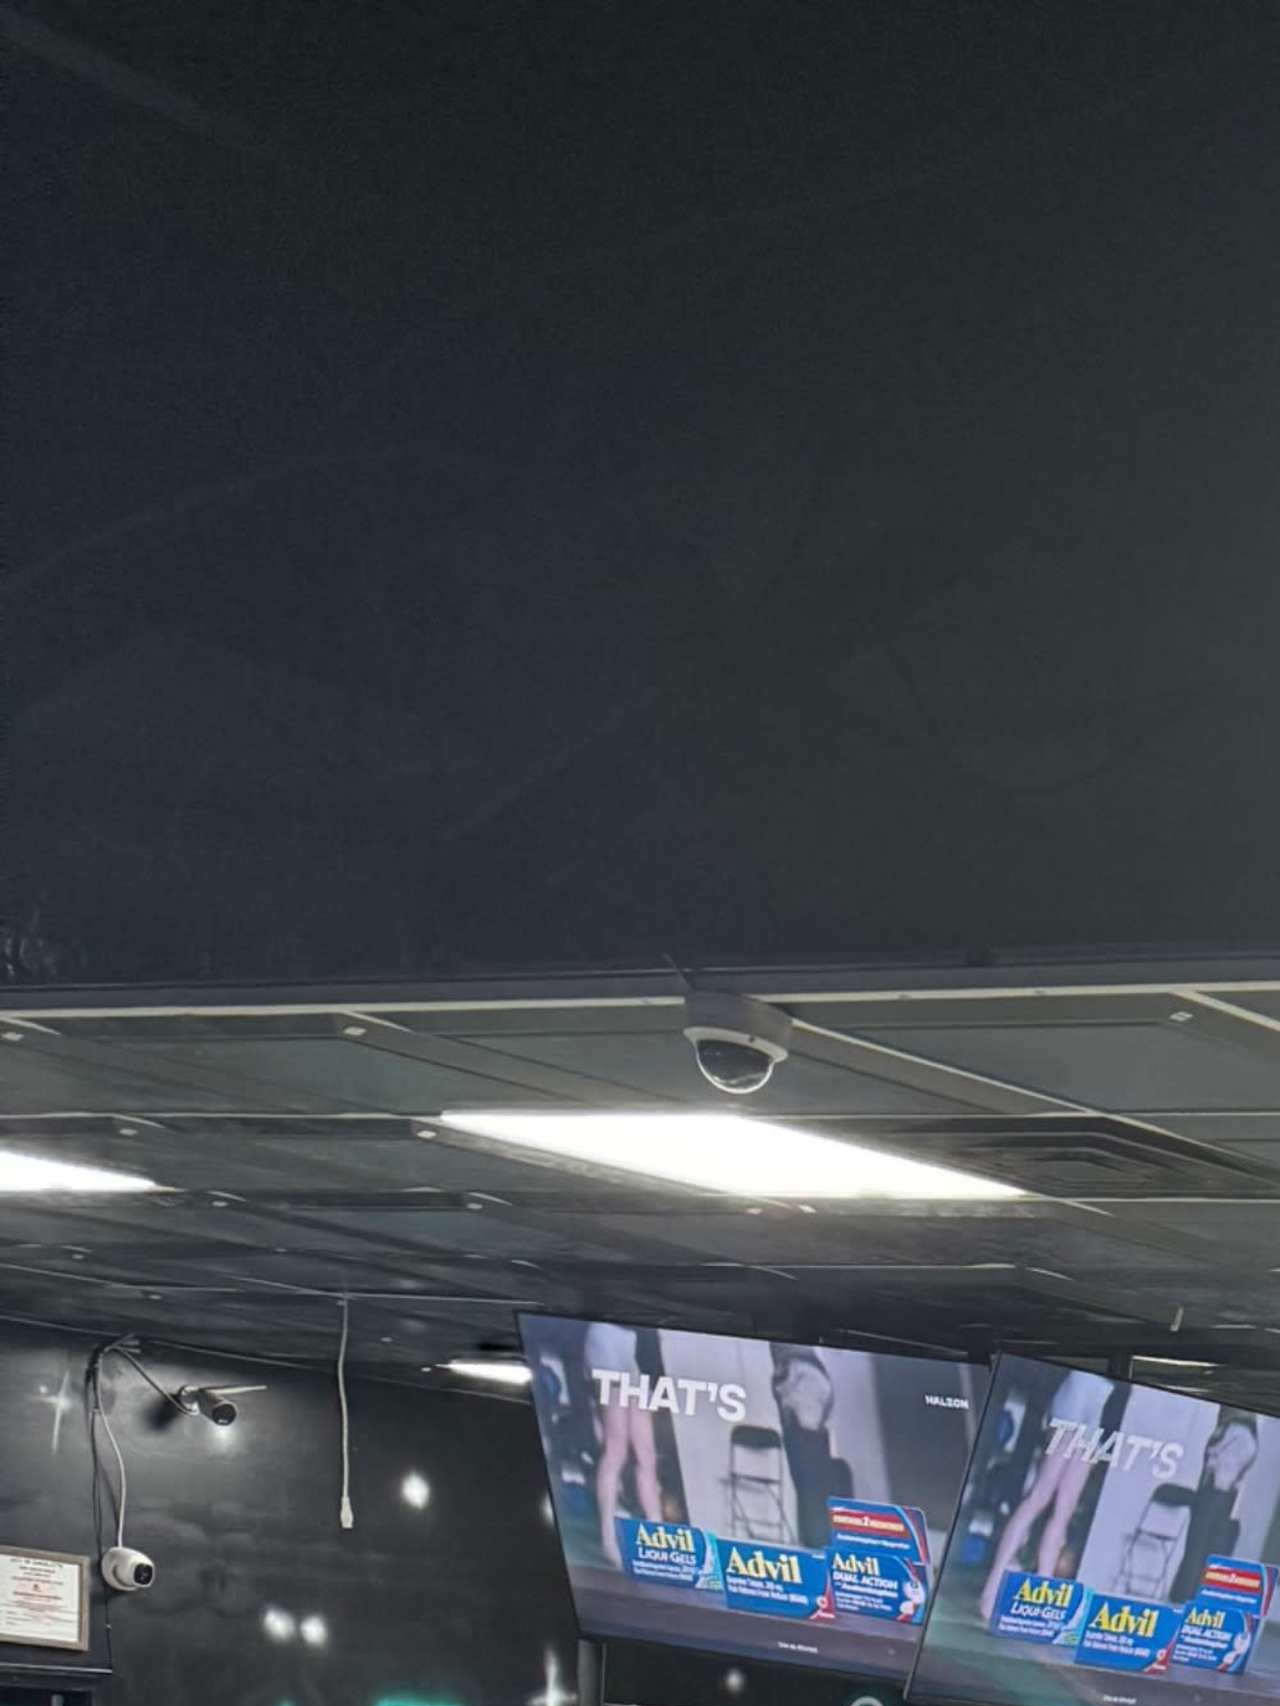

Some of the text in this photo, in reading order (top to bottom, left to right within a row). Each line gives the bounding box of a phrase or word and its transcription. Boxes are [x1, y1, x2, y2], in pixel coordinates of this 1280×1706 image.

[592, 1368, 747, 1424] THAT'S
[1046, 1417, 1184, 1479] THAT'S
[636, 1522, 695, 1552] Advil
[725, 1546, 803, 1584] Advil
[832, 1553, 879, 1576] Advil
[1013, 1577, 1074, 1608] Advil
[1088, 1601, 1159, 1638] Advil
[1184, 1606, 1226, 1630] Advil
